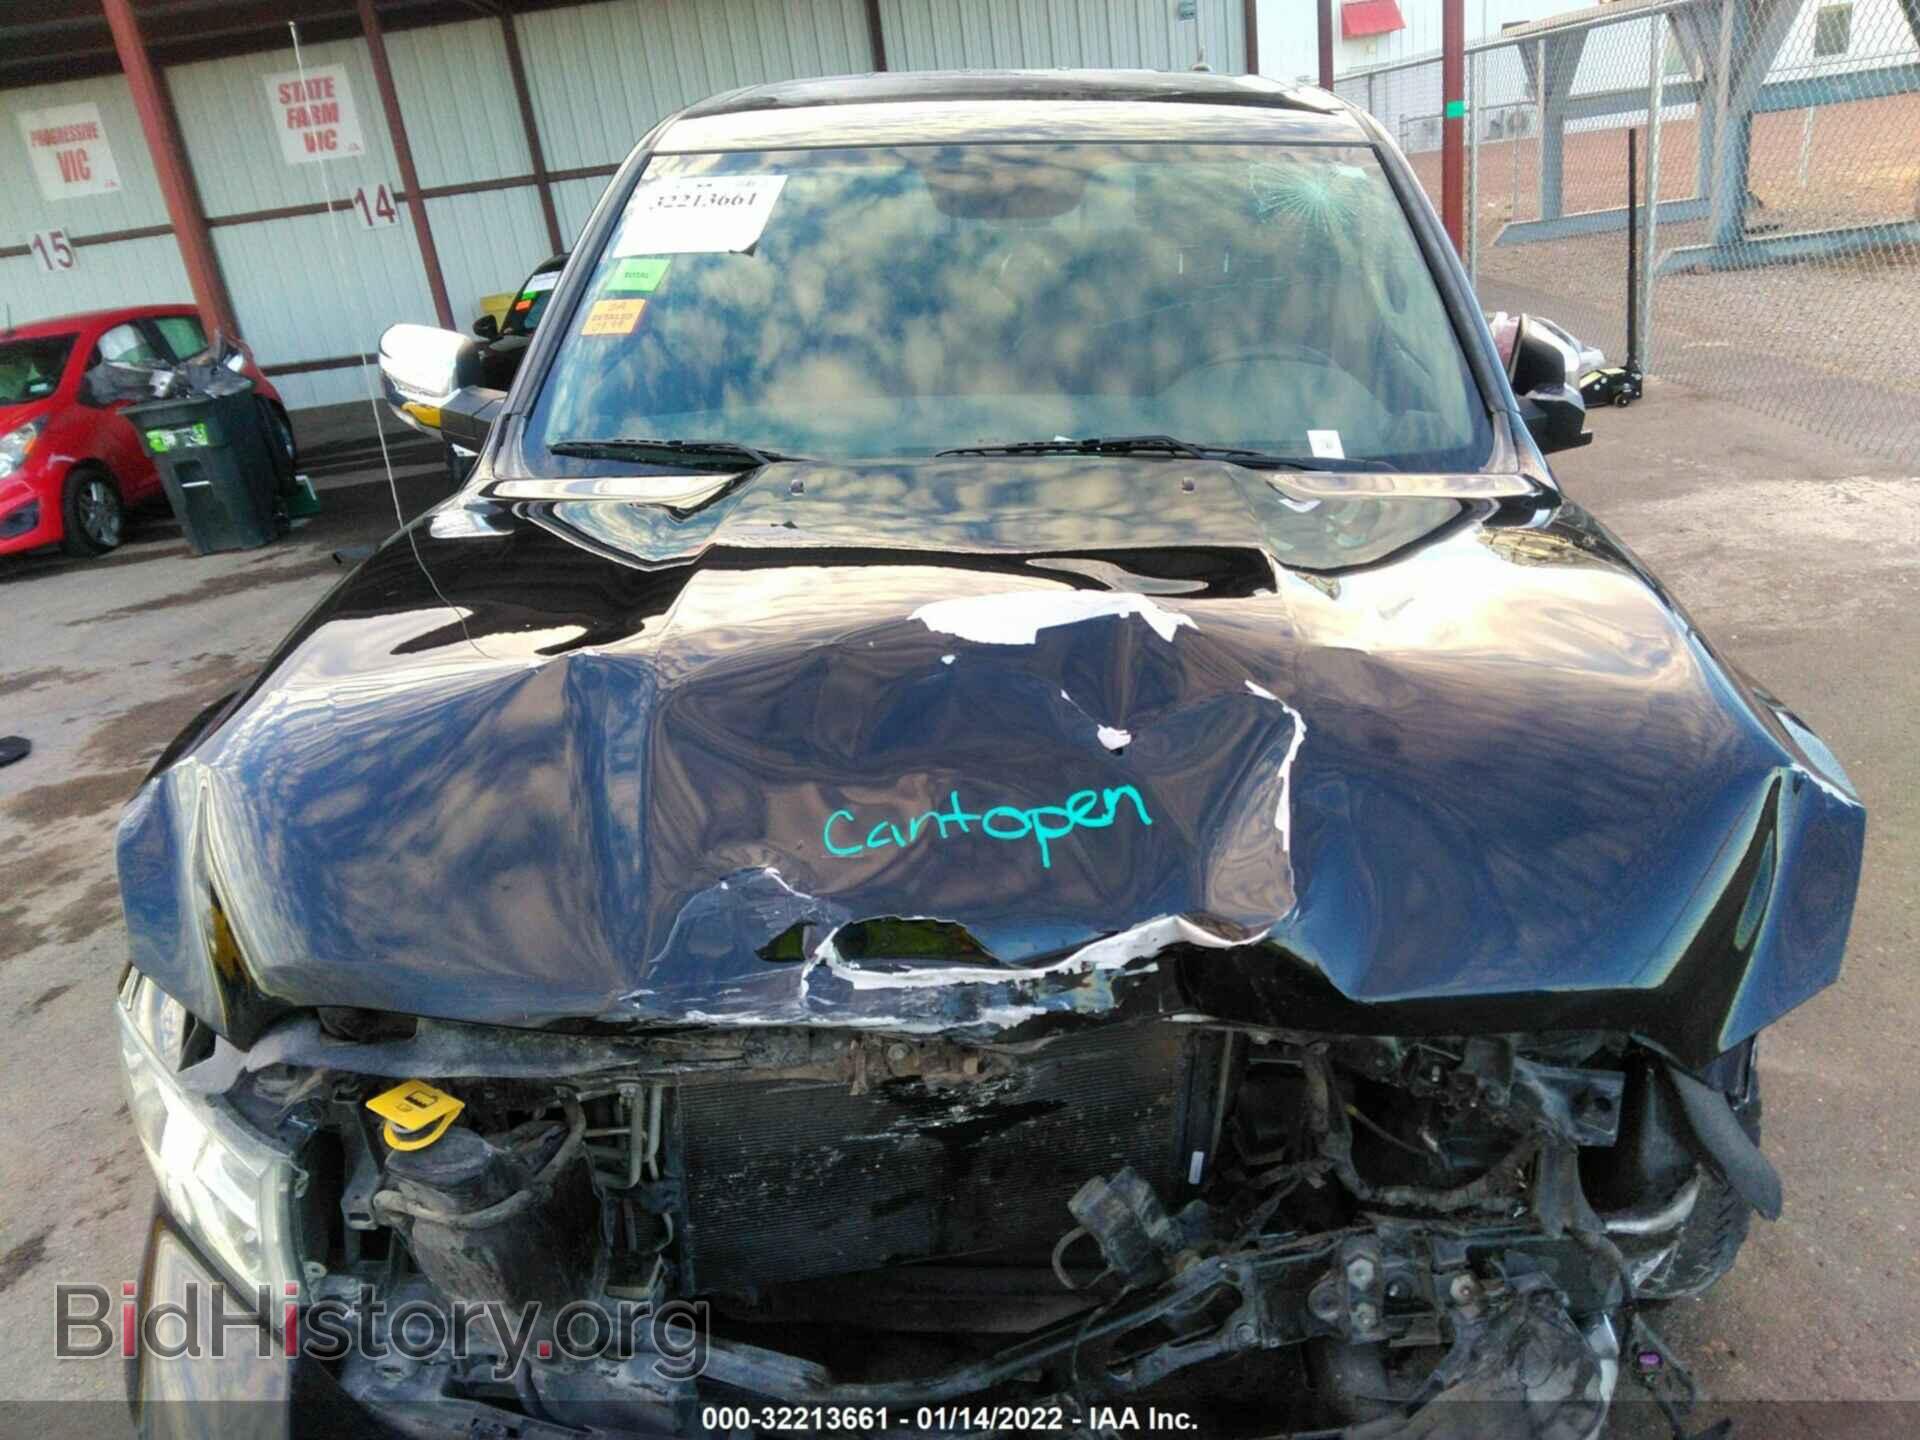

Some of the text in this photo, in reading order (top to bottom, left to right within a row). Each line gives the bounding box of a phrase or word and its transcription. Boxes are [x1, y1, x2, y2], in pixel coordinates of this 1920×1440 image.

[278, 76, 336, 105] STATE
[286, 102, 339, 129] FARM
[29, 121, 99, 147] PROGRESSIVE
[303, 128, 337, 153] VIC
[56, 148, 91, 183] VIC
[354, 184, 395, 227] 14
[33, 229, 74, 270] 15
